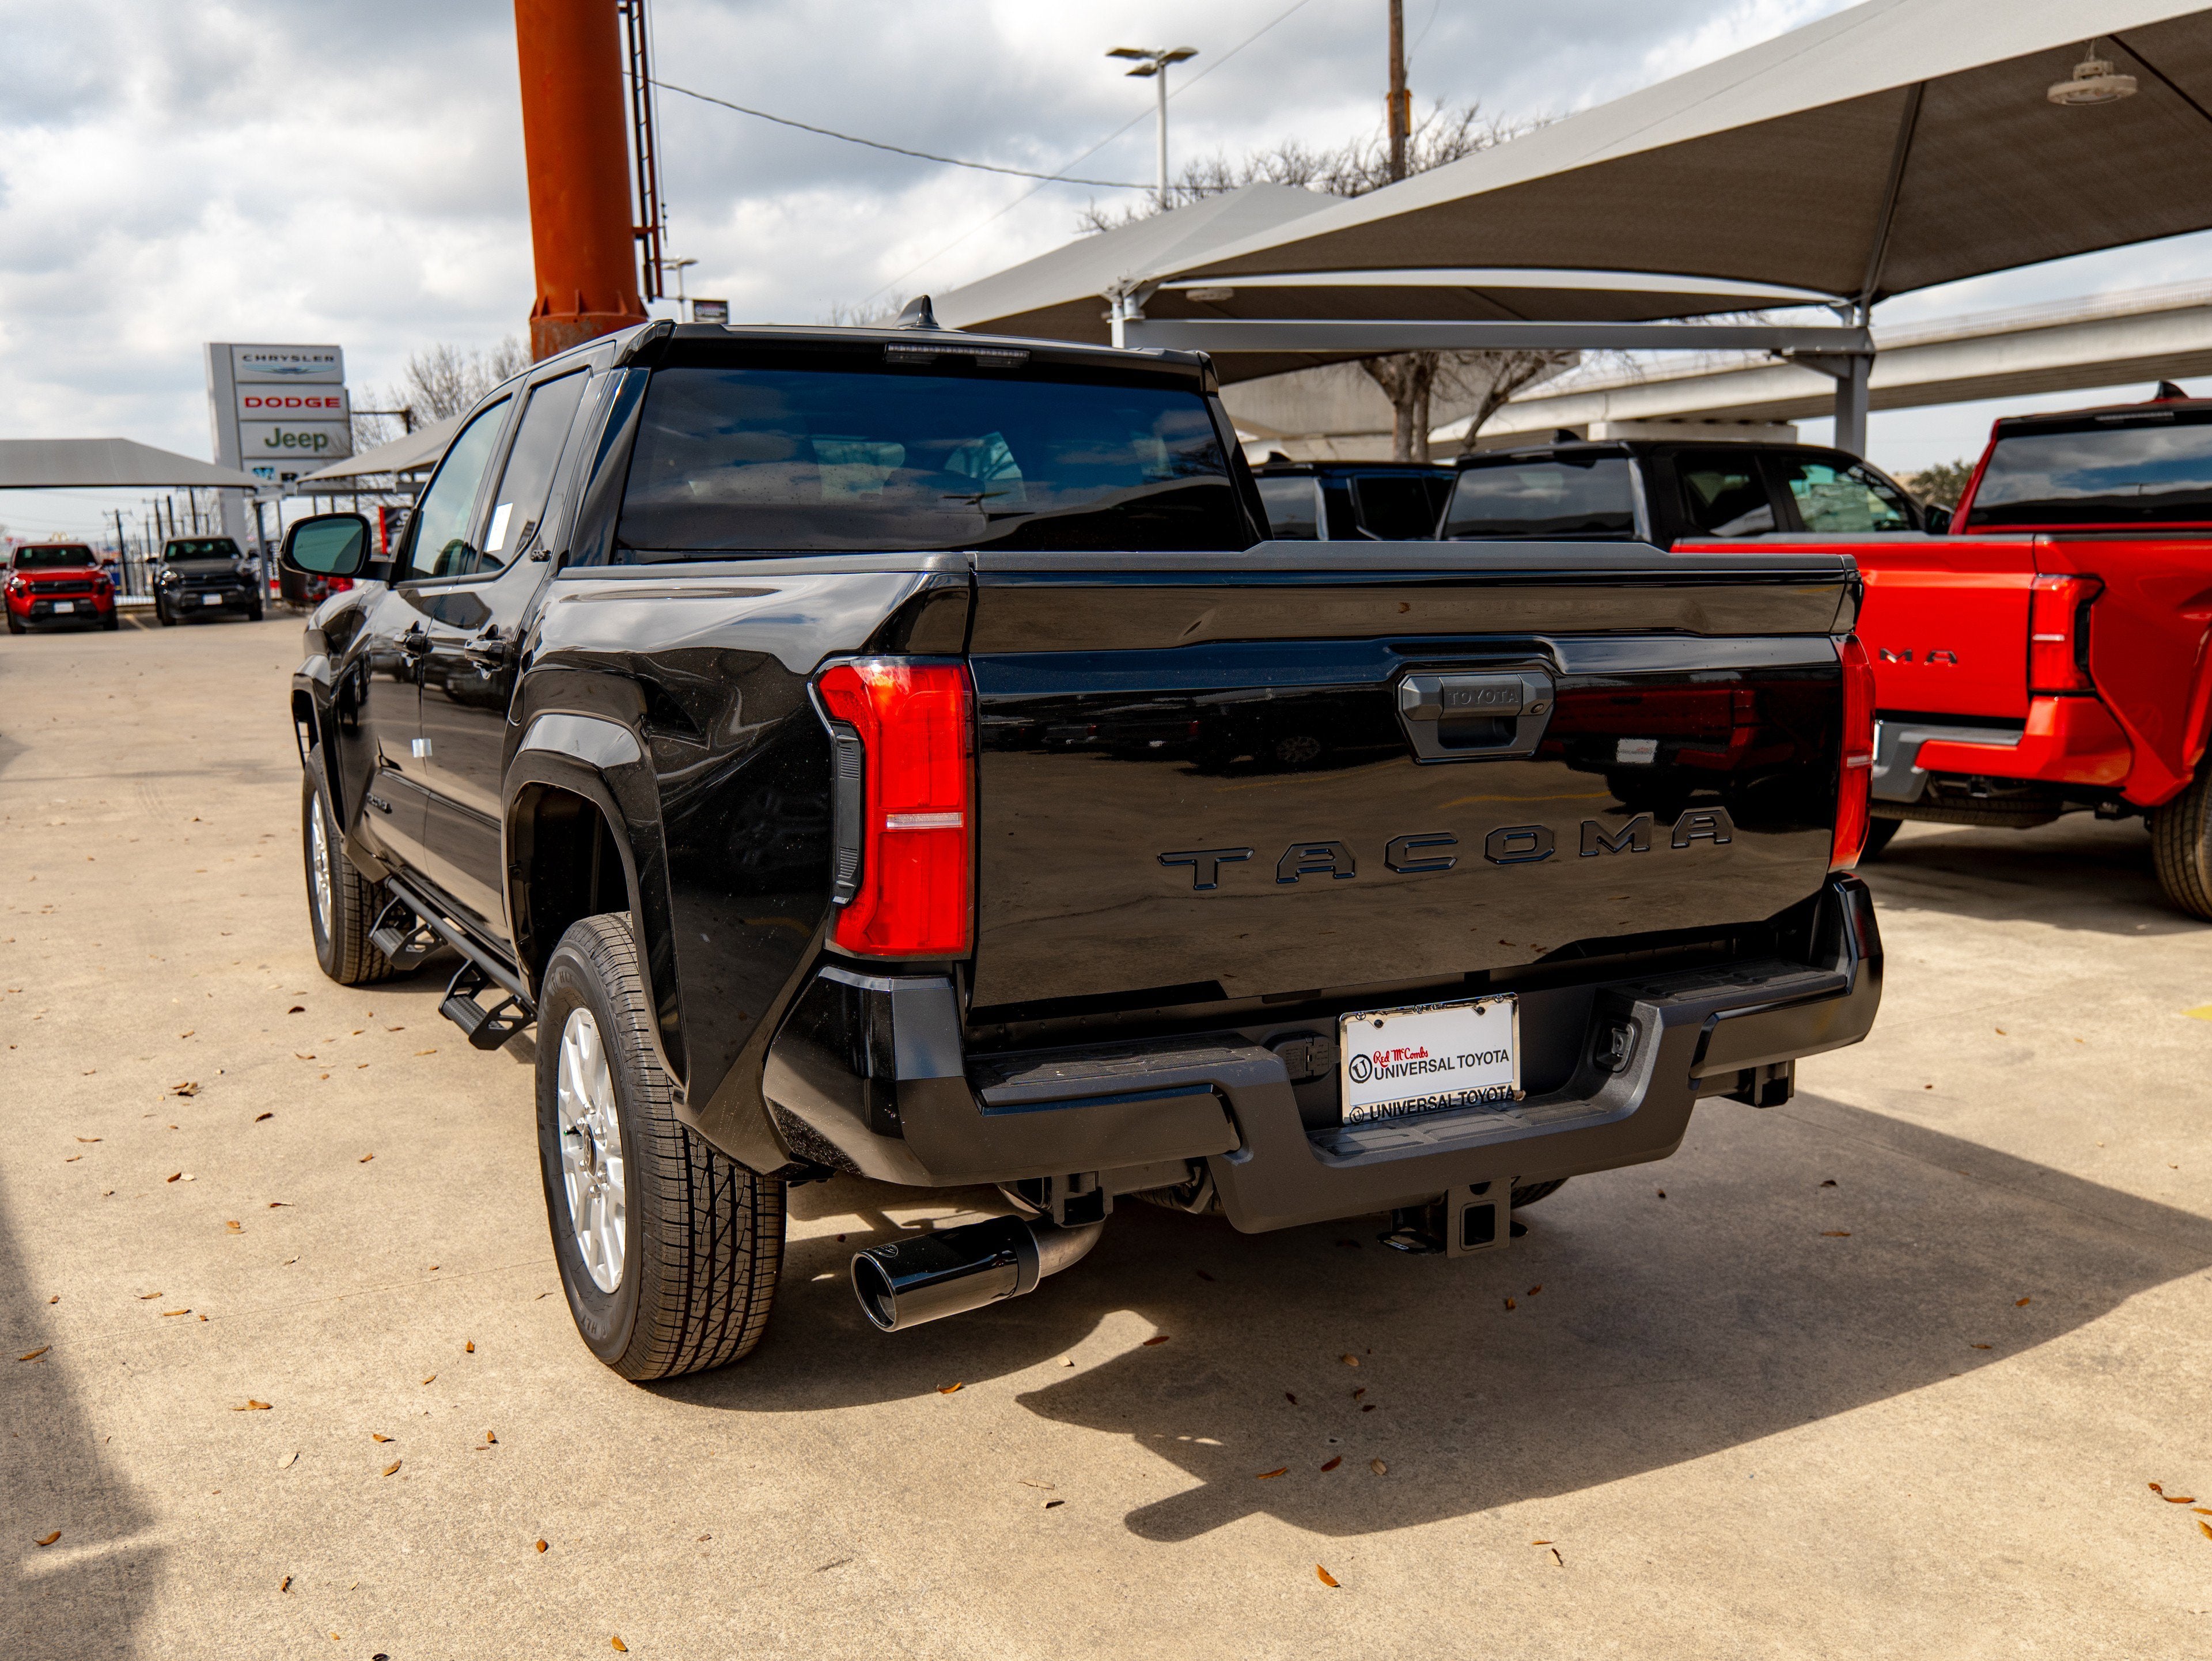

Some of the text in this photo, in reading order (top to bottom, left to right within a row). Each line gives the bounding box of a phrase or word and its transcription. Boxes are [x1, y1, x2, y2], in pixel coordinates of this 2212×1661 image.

[244, 397, 340, 408] DODGE
[264, 427, 328, 452] Jeep
[1448, 688, 1519, 705] TOYOTA
[1156, 807, 1735, 891] TACOMA
[1373, 1050, 1390, 1068] Red
[1374, 1049, 1509, 1080] UNIVERSAL TOYOTA
[1370, 1092, 1457, 1120] UNIVERSAL
[1458, 1085, 1514, 1106] TOYOTA
